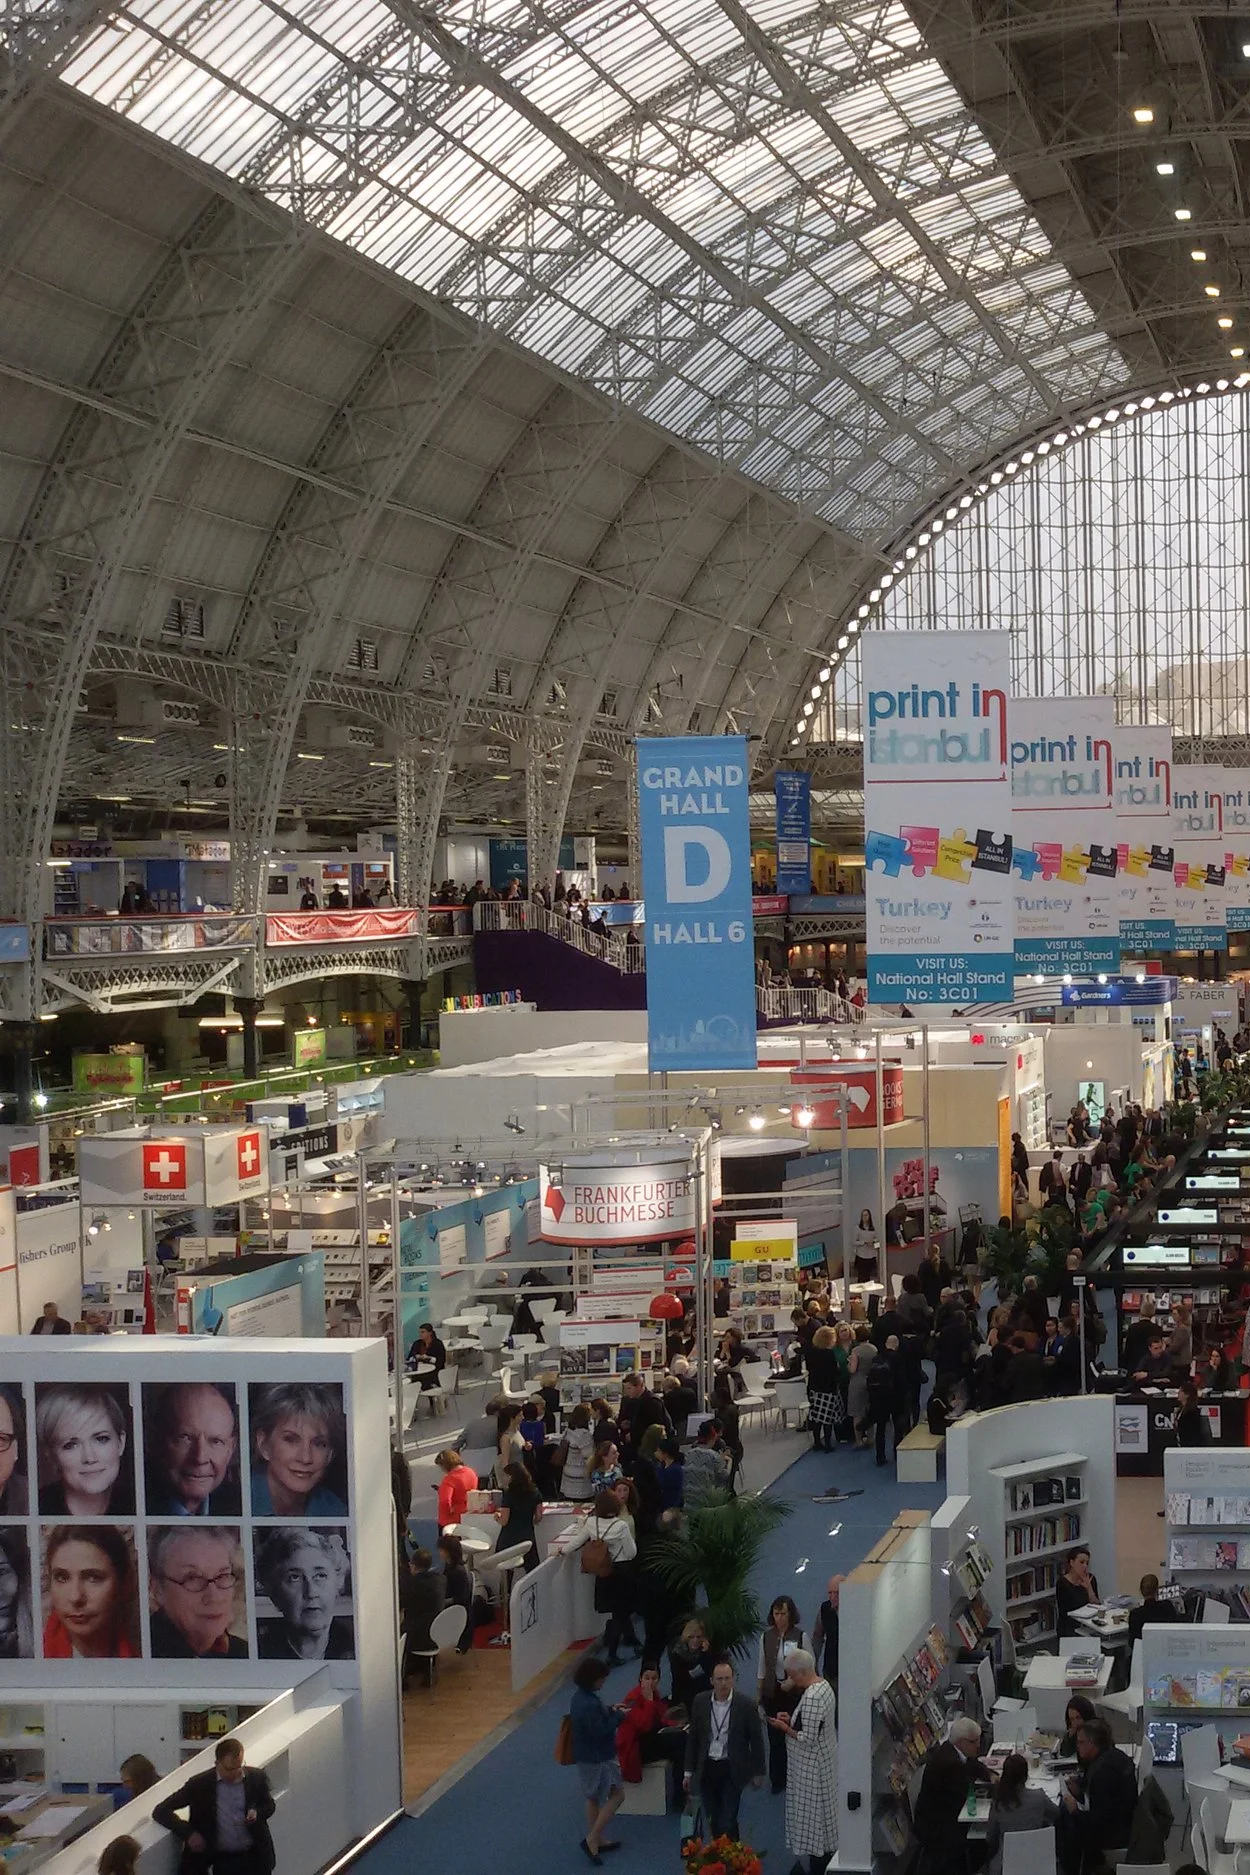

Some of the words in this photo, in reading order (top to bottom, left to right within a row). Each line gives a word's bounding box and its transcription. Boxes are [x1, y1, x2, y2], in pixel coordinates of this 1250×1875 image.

[868, 682, 960, 727] print
[972, 683, 1007, 765] in
[869, 728, 990, 764] istanbul
[1011, 735, 1077, 769] print
[1086, 736, 1113, 796] in
[643, 765, 744, 789] GRAND
[1149, 757, 1171, 806] in
[660, 793, 730, 815] HALL
[51, 845, 112, 857] atador
[664, 826, 732, 904] D
[876, 898, 951, 920] Turkey
[1015, 896, 1073, 913] Turkey
[653, 922, 722, 944] HALL
[728, 921, 746, 943] 6
[880, 924, 921, 934] Discover
[880, 936, 894, 945] the
[898, 935, 941, 946] potential
[1046, 941, 1068, 950] VISIT
[916, 957, 946, 968] VISIT
[949, 957, 968, 968] US:
[1015, 952, 1060, 963] National
[1062, 951, 1081, 962] Hall
[1083, 950, 1113, 961] Stand
[1063, 962, 1093, 973] 3C01
[876, 972, 933, 985] National
[937, 972, 963, 985] Hall
[966, 971, 1006, 984] Stand
[906, 988, 933, 1000] No:
[939, 987, 978, 1000] 3C01
[1081, 991, 1112, 1000] Gardners
[1191, 991, 1225, 1000] FABER
[574, 1180, 691, 1205] FRANKFURTER
[574, 1201, 675, 1223] BUCHMESSE
[50, 1241, 77, 1260] Group
[754, 1245, 770, 1254] GU
